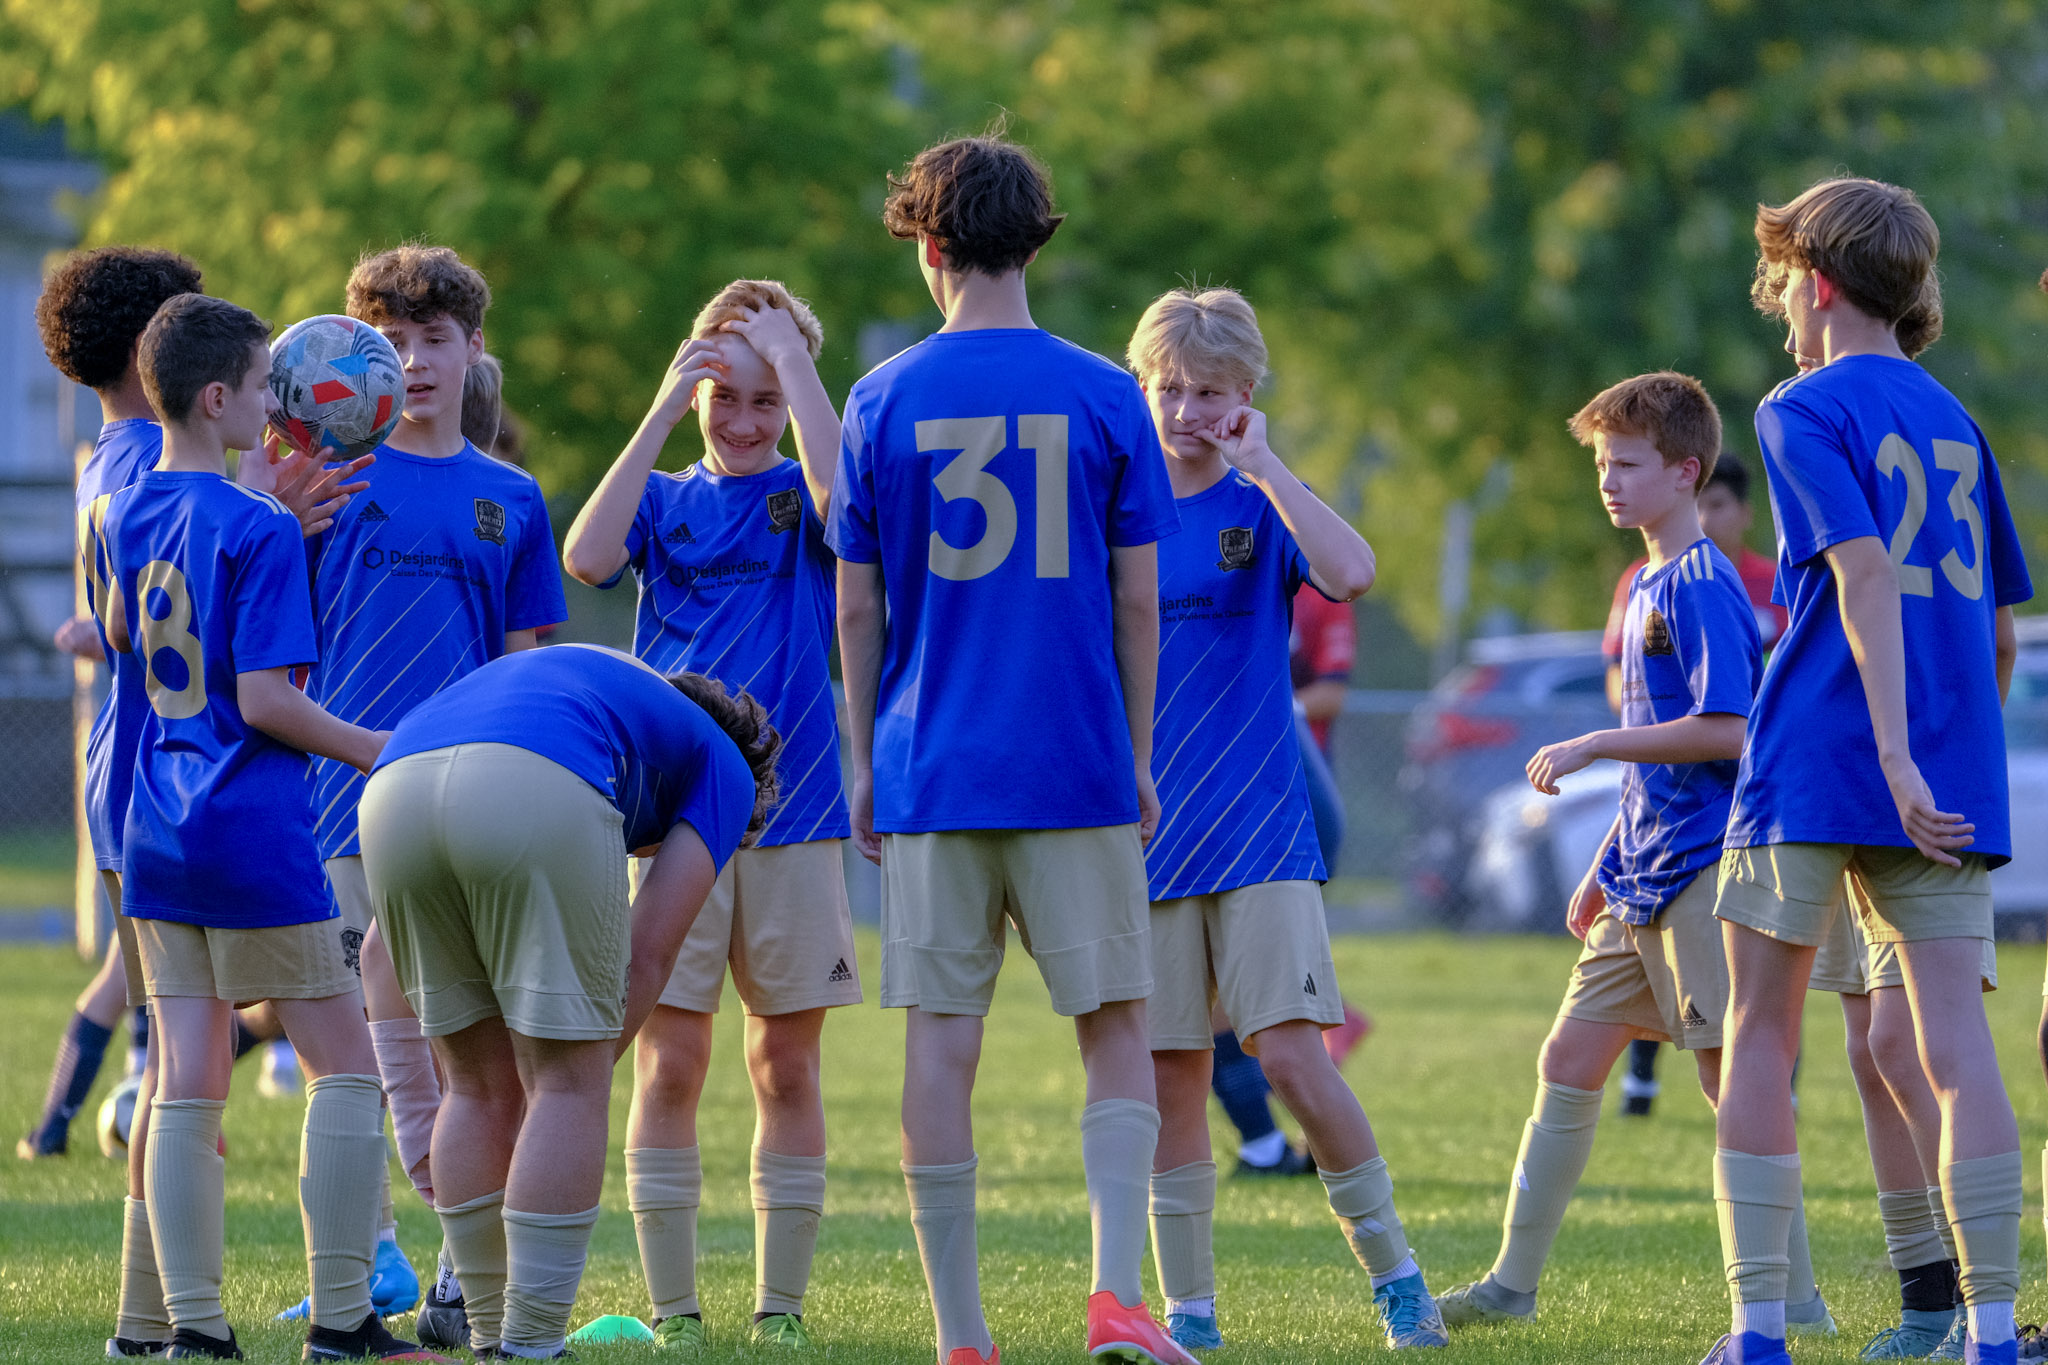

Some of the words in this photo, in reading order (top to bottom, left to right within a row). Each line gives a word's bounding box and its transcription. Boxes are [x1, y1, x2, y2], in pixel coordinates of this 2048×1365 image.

[914, 413, 1070, 581] 31
[355, 513, 390, 524] adidas
[1875, 432, 1984, 600] 23
[662, 536, 697, 544] adidas
[390, 550, 465, 569] Desjardins
[418, 569, 433, 578] Des
[687, 558, 770, 581] Desjardins
[1162, 614, 1177, 624] Des
[137, 560, 208, 719] 8
[829, 972, 853, 982] adidas
[1682, 1018, 1707, 1027] adidas
